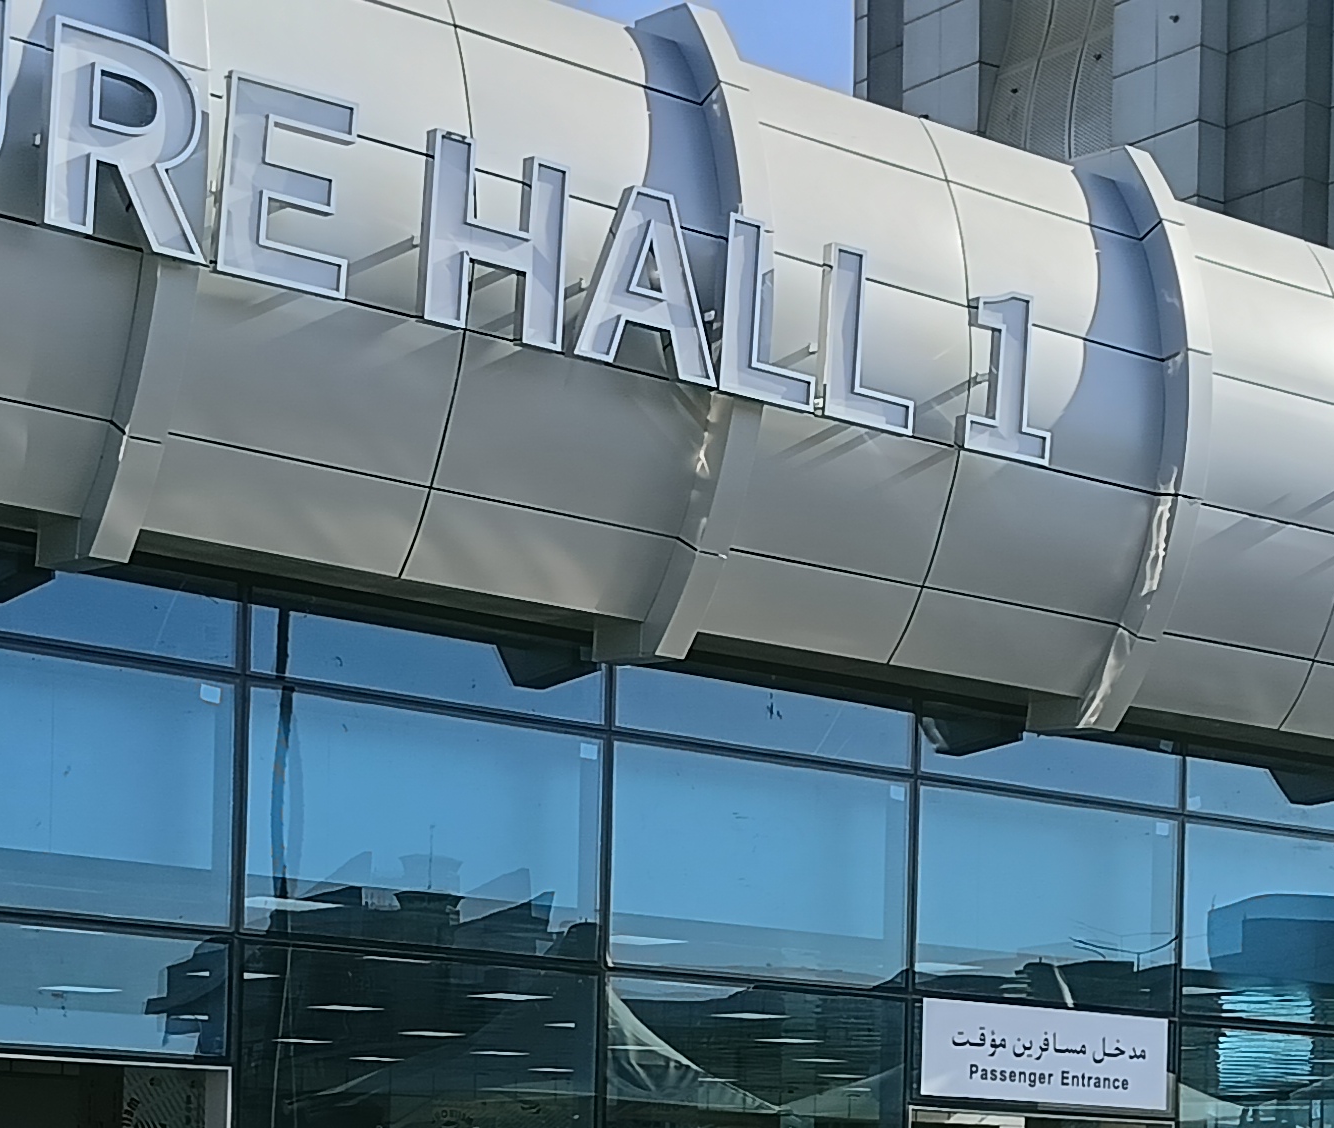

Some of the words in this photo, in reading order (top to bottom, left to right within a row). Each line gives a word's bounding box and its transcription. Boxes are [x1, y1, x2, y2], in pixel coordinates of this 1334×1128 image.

[419, 129, 913, 435] HALL
[957, 293, 1051, 467] 1
[952, 1027, 1007, 1057] مؤقت
[1012, 1031, 1087, 1061] مسافرين
[1092, 1037, 1147, 1064] مدخل
[969, 1063, 1054, 1088] Passenger
[1060, 1071, 1130, 1091] Entrance
